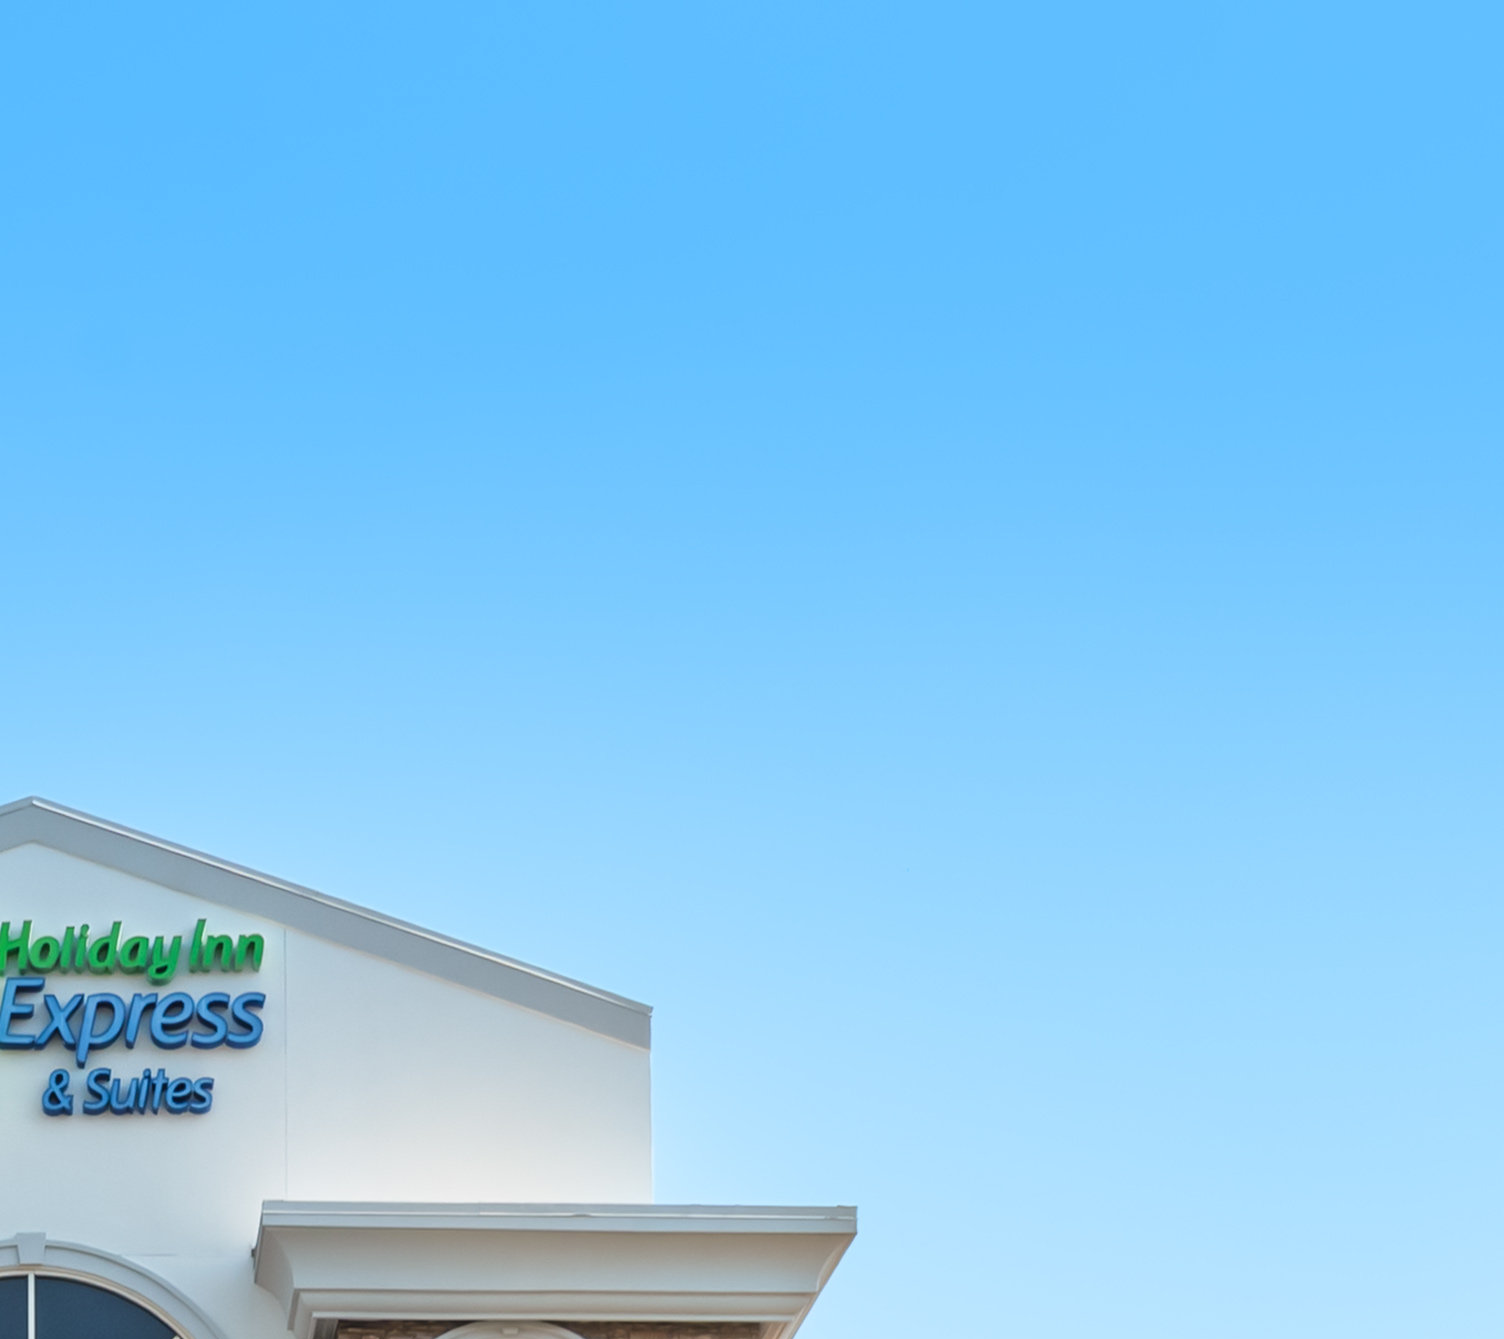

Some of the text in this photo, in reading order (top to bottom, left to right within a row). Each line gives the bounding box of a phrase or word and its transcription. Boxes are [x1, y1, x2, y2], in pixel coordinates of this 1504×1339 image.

[189, 918, 264, 973] Inn
[42, 1068, 214, 1116] & Suites
